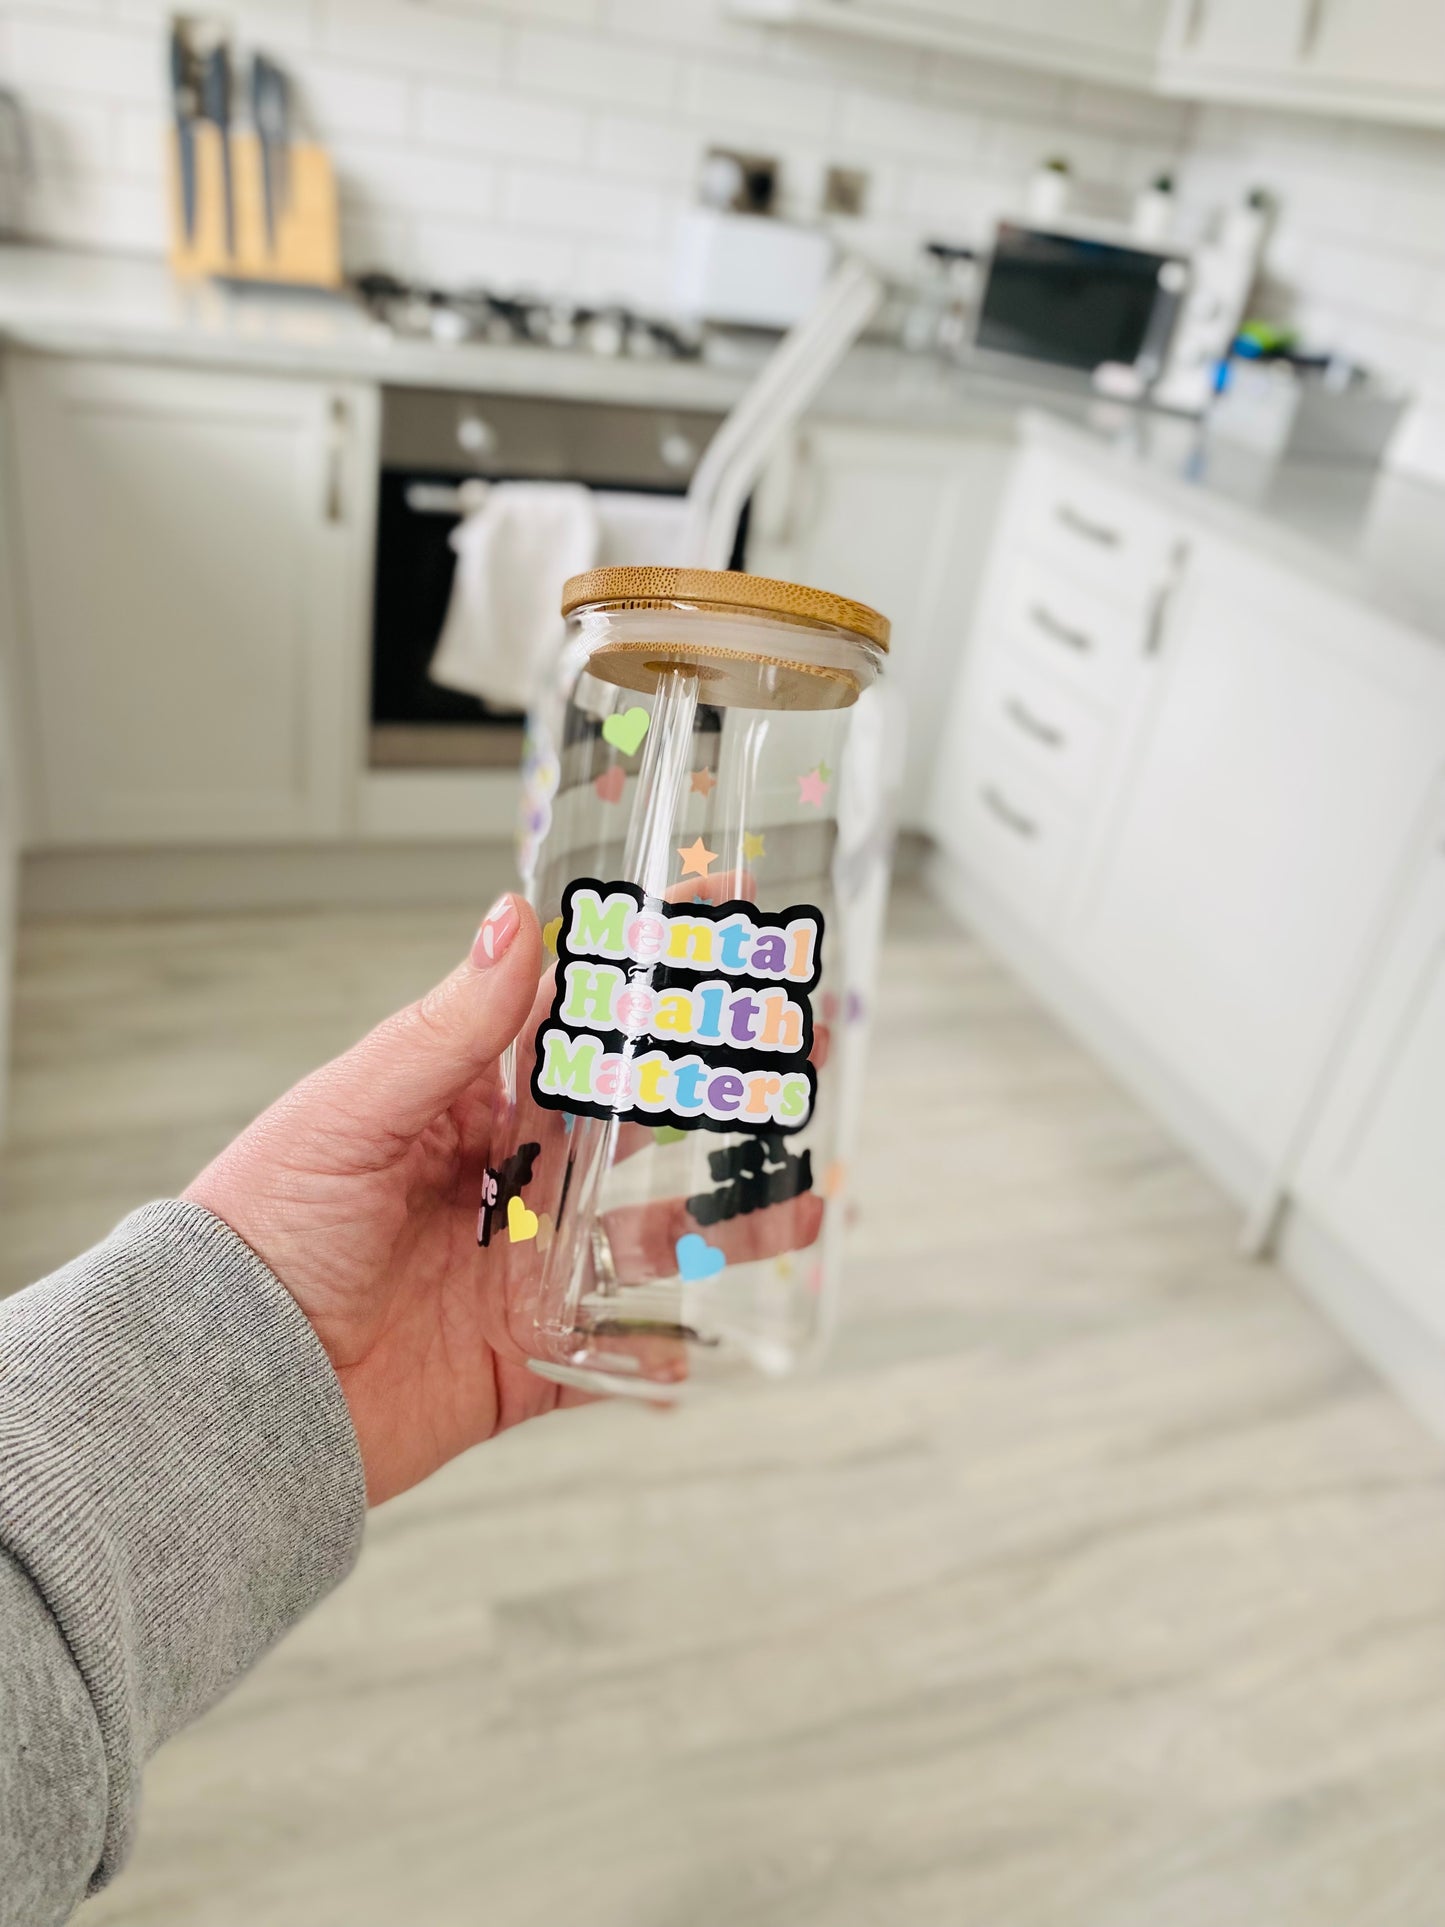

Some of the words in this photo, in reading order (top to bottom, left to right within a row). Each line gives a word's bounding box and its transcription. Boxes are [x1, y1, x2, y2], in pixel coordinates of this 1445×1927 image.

[572, 897, 812, 978] Mental
[565, 968, 801, 1047] Health
[543, 1038, 807, 1117] Matters
